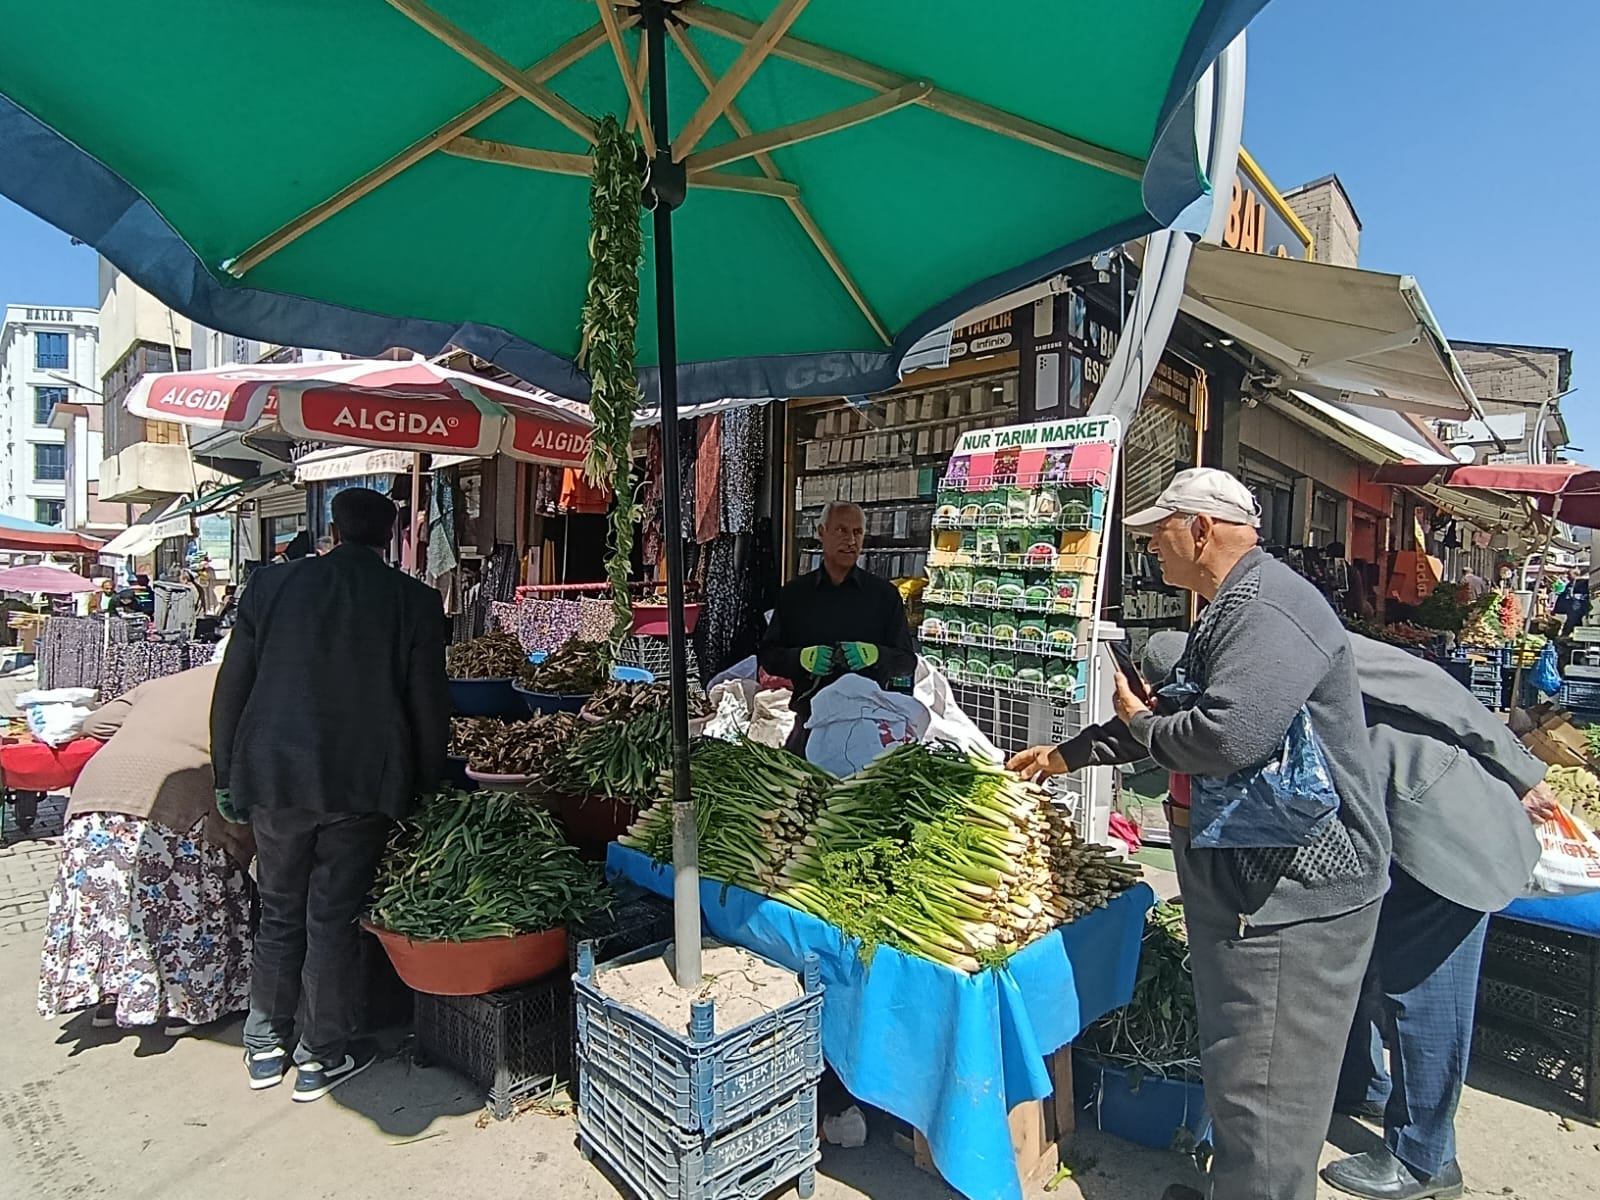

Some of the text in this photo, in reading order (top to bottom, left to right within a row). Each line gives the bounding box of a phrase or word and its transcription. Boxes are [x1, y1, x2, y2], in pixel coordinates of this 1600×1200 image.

[26, 309, 73, 321] HANLAR
[1035, 341, 1062, 352] SAMSUNG
[963, 421, 1109, 450] NUR TARIM MARKET
